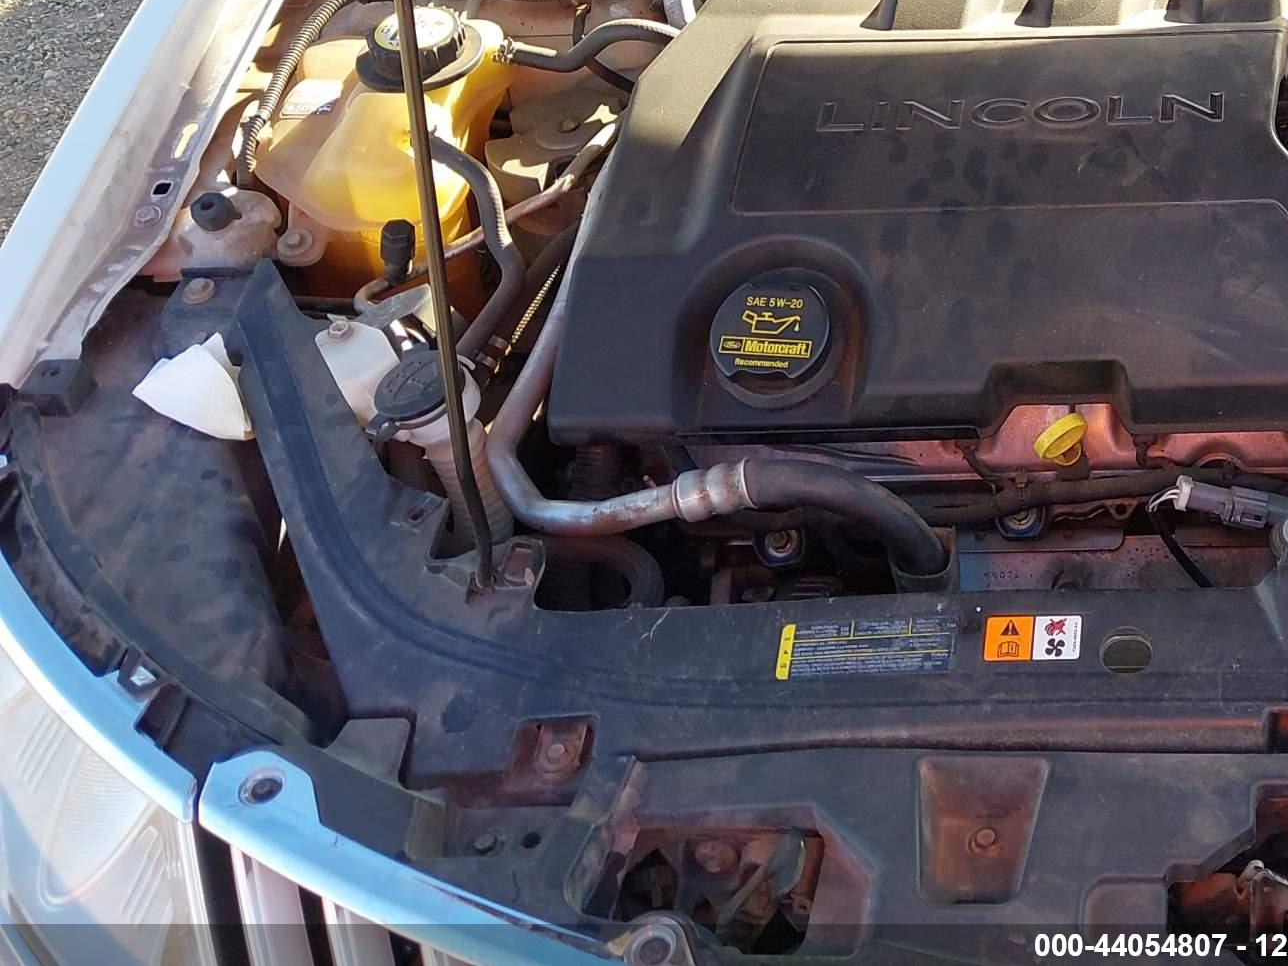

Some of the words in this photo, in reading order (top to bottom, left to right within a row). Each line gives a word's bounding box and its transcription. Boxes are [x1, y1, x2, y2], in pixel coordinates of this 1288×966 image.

[816, 92, 1225, 132] LINCOLN
[746, 296, 767, 307] SAE
[768, 297, 804, 309] 5W-20
[744, 339, 808, 355] Motorcraft
[734, 357, 789, 369] Recommended
